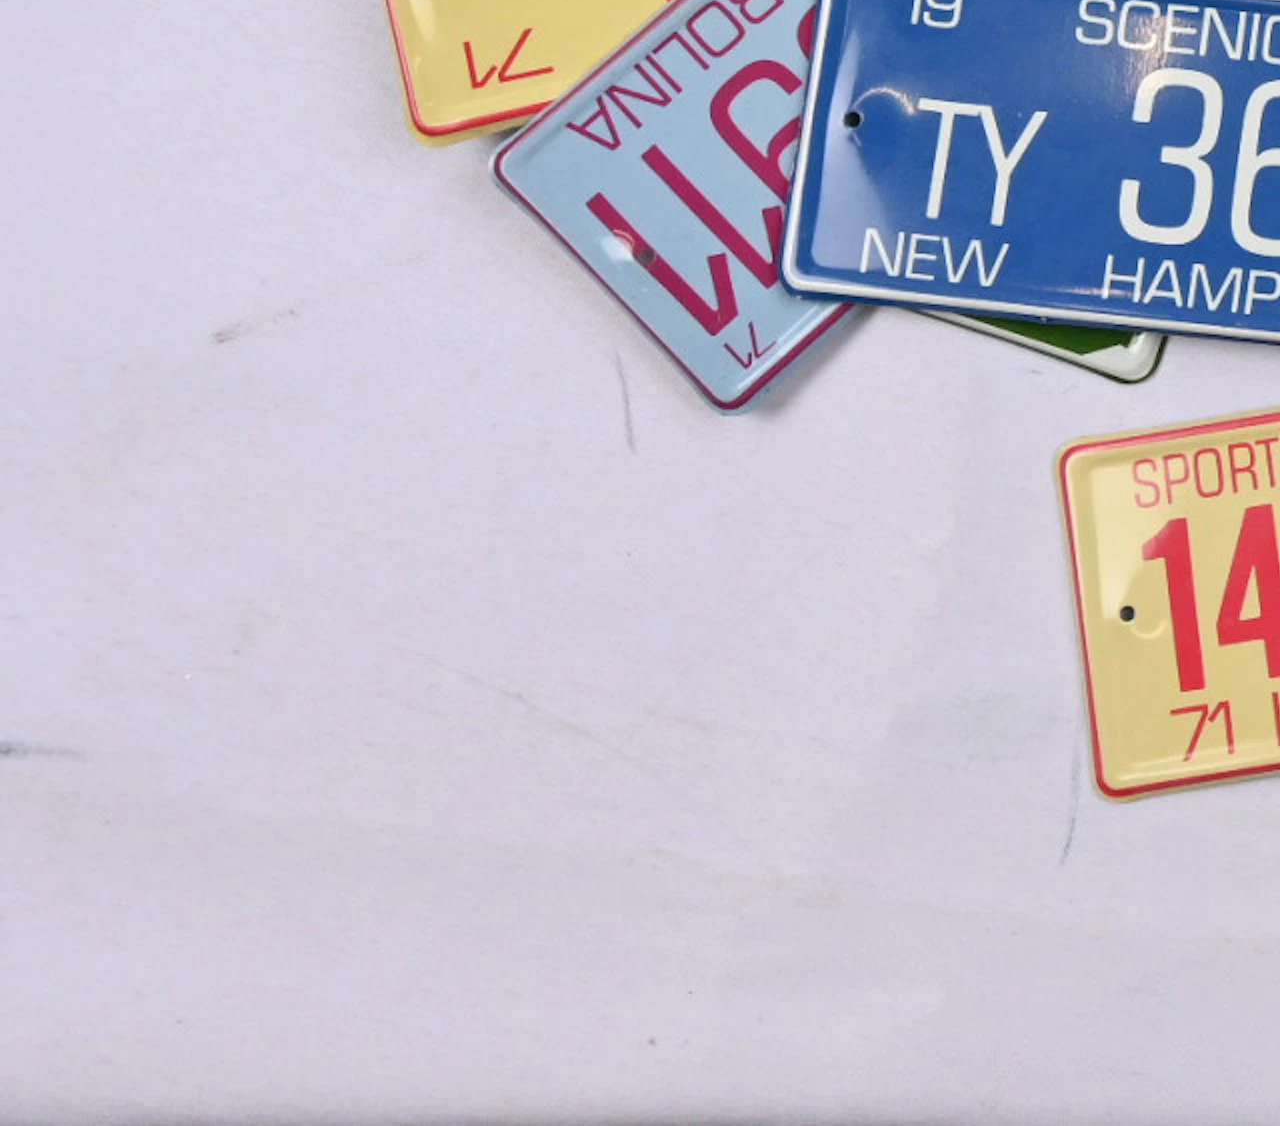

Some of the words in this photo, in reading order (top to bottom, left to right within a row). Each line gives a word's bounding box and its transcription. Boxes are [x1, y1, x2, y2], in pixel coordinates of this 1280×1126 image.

[462, 28, 553, 90] 71
[916, 98, 1048, 227] TY
[858, 228, 1008, 286] NEW
[724, 323, 778, 369] 71
[1170, 701, 1235, 762] 71
